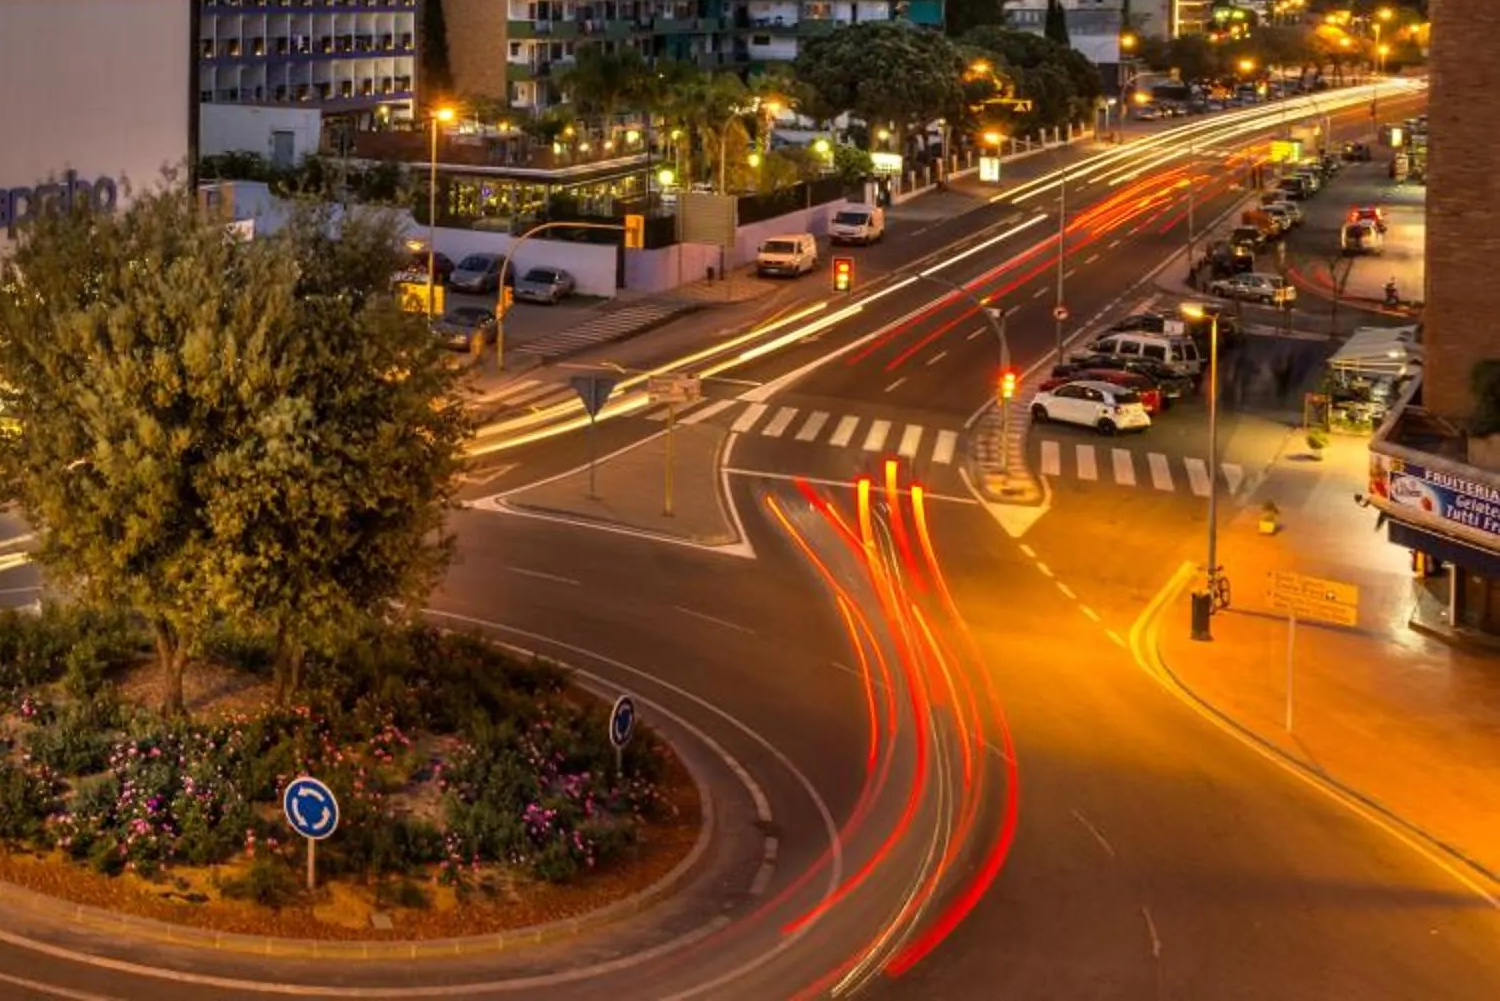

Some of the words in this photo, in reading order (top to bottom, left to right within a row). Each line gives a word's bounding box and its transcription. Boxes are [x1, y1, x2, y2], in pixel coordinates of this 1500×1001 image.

[1425, 470, 1500, 500] FRUITERIA
[1455, 495, 1500, 518] Gelate
[1484, 515, 1500, 533] Fr
